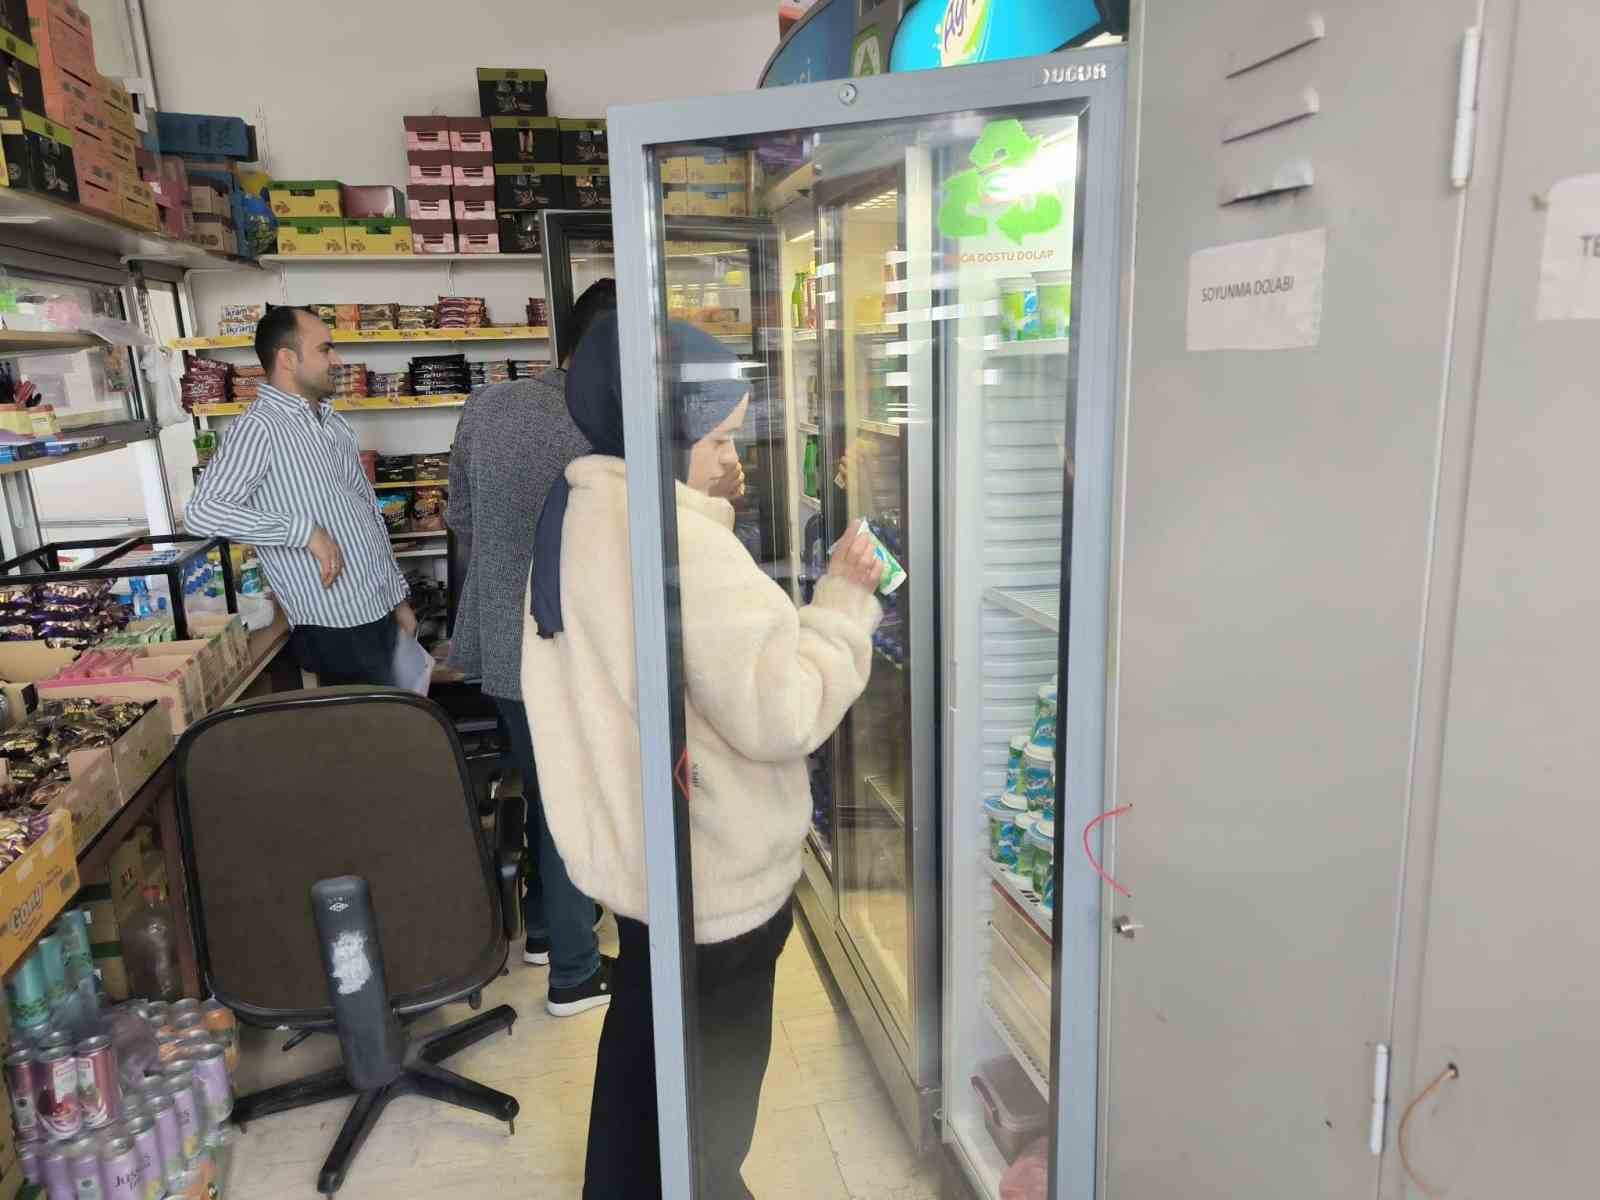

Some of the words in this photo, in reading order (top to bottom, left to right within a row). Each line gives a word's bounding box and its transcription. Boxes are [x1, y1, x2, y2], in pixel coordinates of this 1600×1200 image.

[1016, 249, 1054, 261] DOLAP
[1201, 281, 1252, 302] SOYUNMA
[1254, 275, 1295, 295] DOLABI
